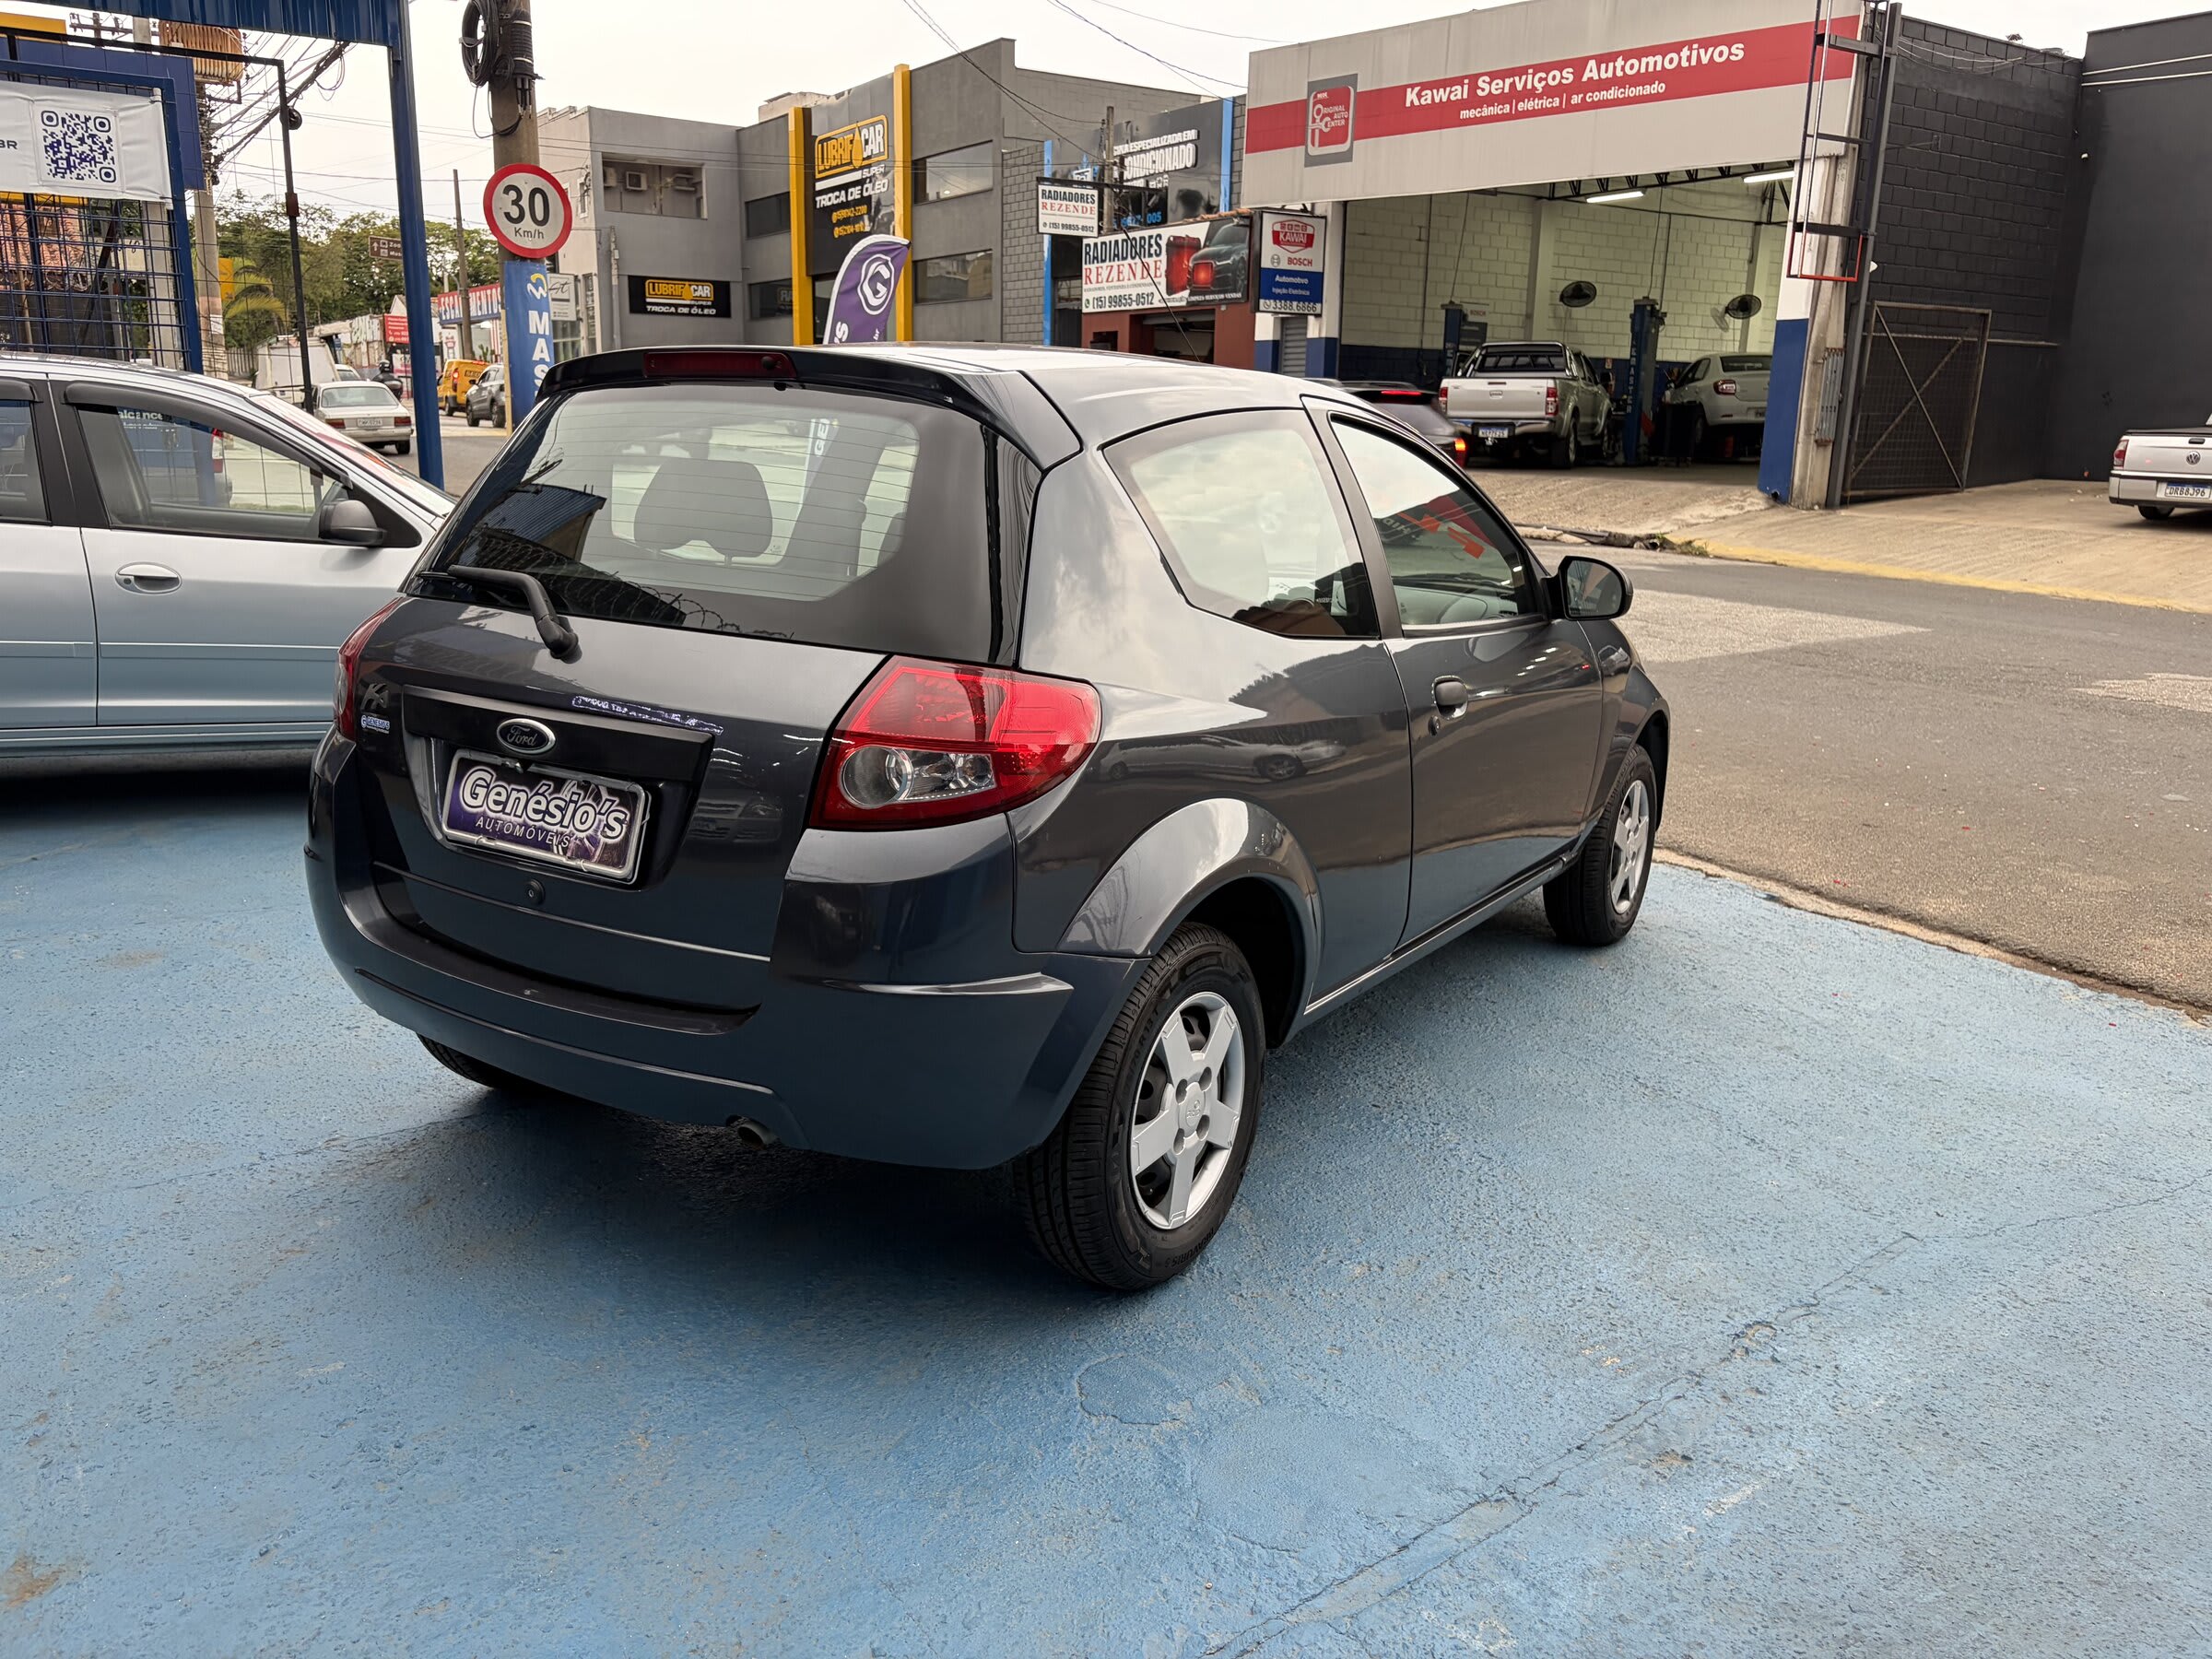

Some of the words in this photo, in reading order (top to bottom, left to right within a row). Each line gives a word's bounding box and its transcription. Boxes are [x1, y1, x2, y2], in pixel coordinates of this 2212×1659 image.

[1406, 79, 1469, 107] Kawai
[1477, 66, 1574, 96] Serviços
[1582, 42, 1745, 82] Automotivos
[1460, 103, 1510, 120] mecânica
[1517, 96, 1559, 112] elétrica
[1571, 93, 1583, 105] ar
[1585, 81, 1665, 103] condicionado
[502, 184, 549, 227] 30
[816, 190, 846, 208] TROCA
[848, 185, 861, 201] DE
[863, 178, 888, 196] ÓLEO
[1041, 189, 1096, 205] RADIADORES
[1041, 202, 1096, 215] REZENDE
[514, 227, 544, 240] Km/h
[1279, 231, 1308, 244] KAWAI
[1084, 233, 1162, 265] RADIADORES
[1288, 256, 1313, 267] BOSCH
[1084, 259, 1162, 285] REZENDE
[440, 287, 501, 321] ESCAMENTOS
[690, 305, 716, 315] ÓLEO
[1092, 296, 1107, 310] (15)
[1108, 292, 1154, 309] 99855-0512
[507, 724, 537, 747] Ford
[462, 769, 629, 841] Genésio's
[476, 817, 571, 848] AUTOMÓVEIS
